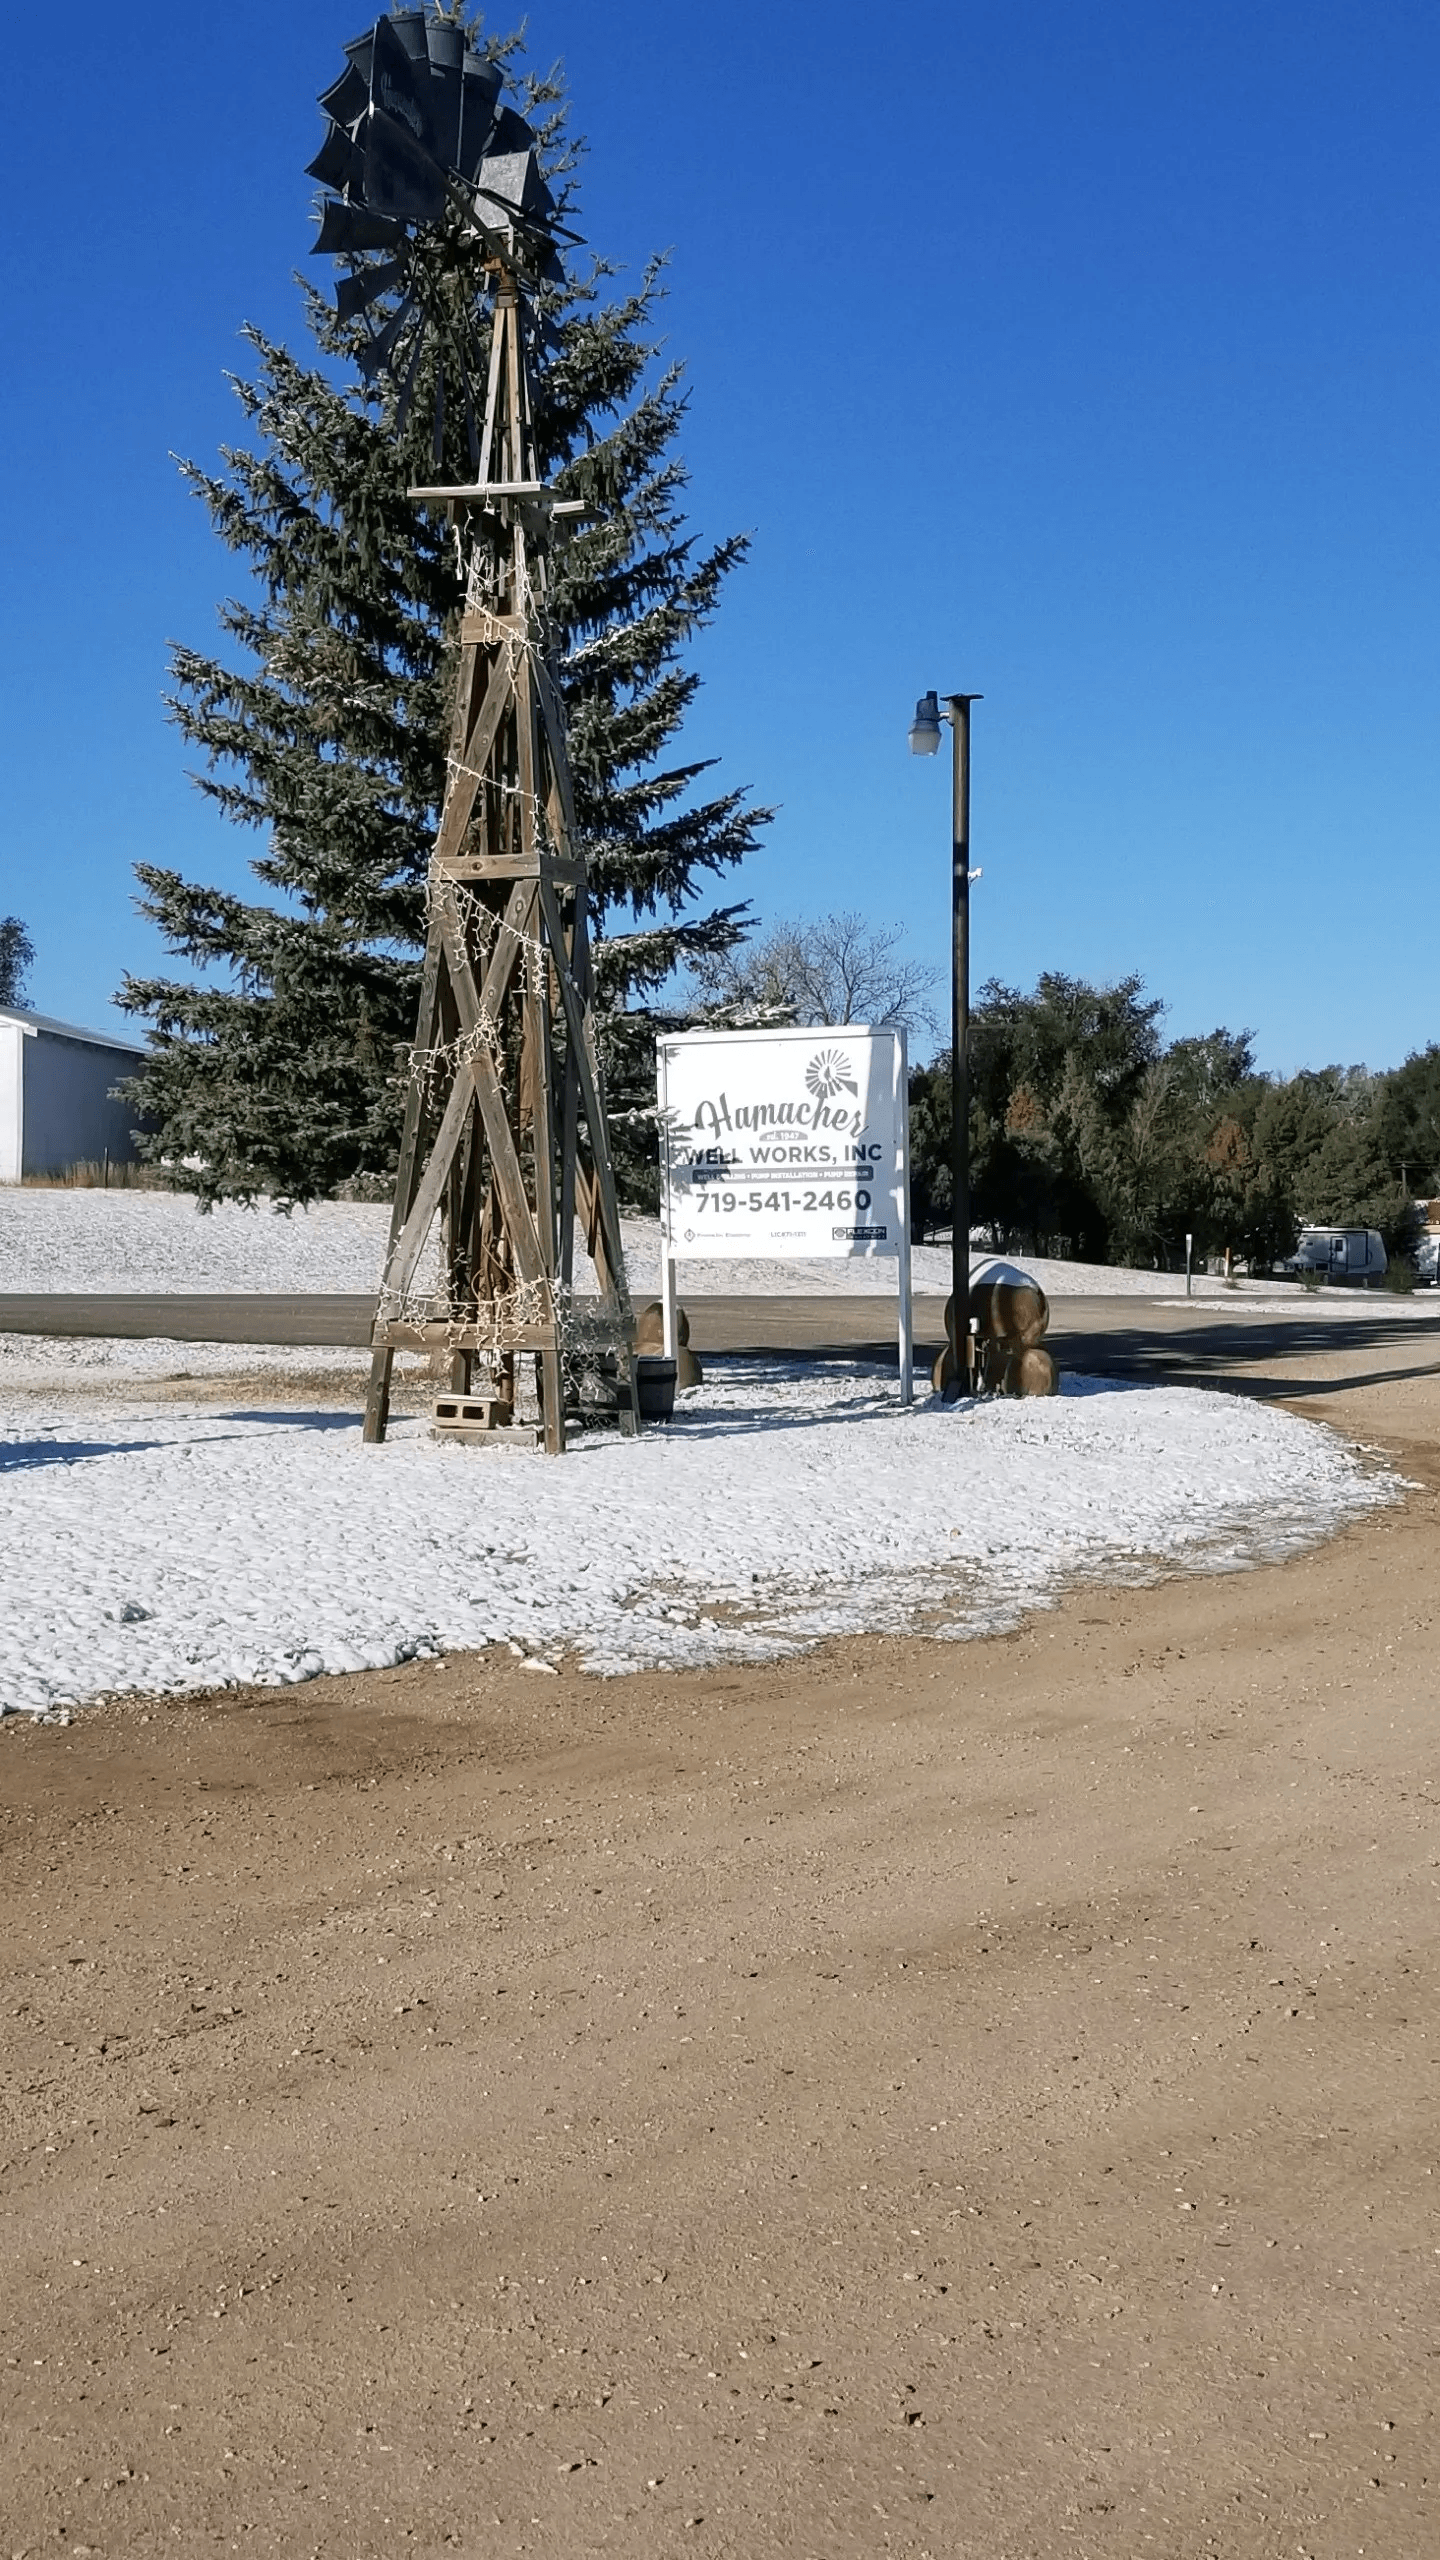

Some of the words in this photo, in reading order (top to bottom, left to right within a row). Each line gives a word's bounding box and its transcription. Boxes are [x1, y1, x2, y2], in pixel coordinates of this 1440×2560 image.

[695, 1092, 869, 1140] Hamacher
[683, 1148, 743, 1165] WELL
[749, 1145, 838, 1165] WORKS,
[844, 1143, 883, 1162] INC
[696, 1190, 872, 1213] 719-541-2460
